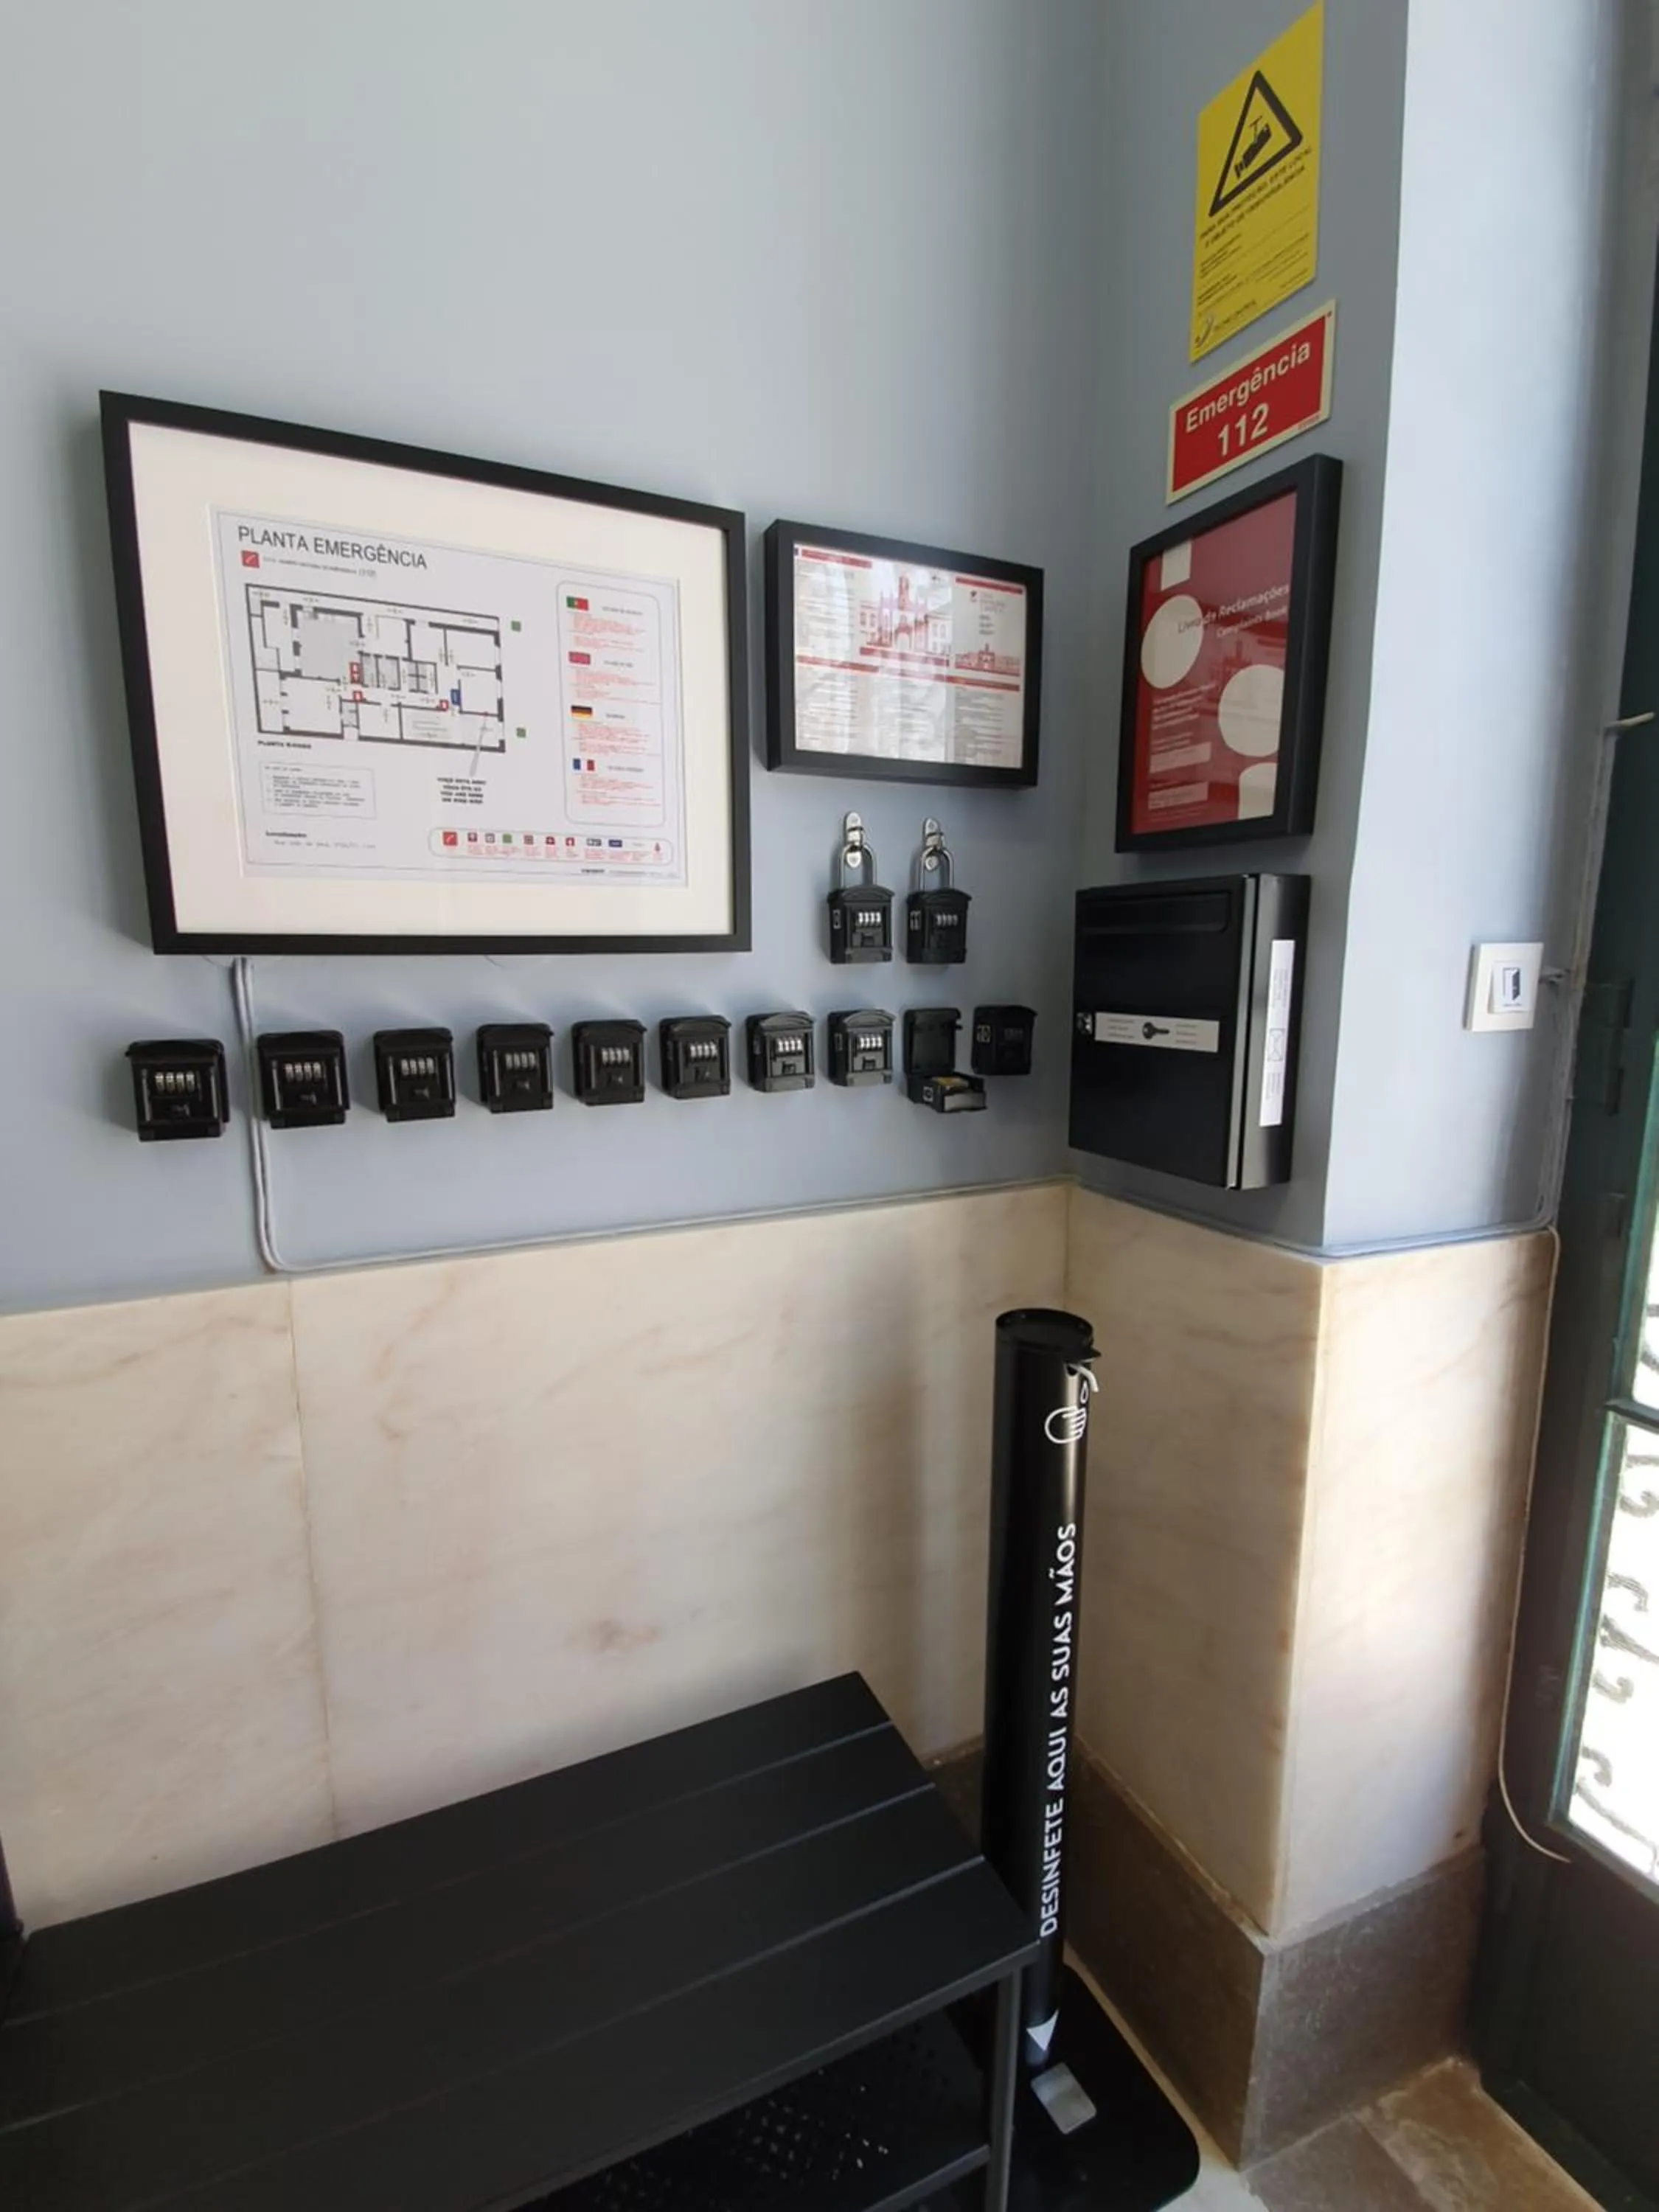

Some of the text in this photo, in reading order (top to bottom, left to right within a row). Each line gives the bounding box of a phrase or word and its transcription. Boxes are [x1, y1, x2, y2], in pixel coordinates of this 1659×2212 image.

[1186, 341, 1310, 433] Emergência
[1218, 403, 1269, 456] 112
[238, 526, 309, 552] PLANTA
[314, 538, 428, 569] EMERGÊNCIA
[1040, 1523, 1077, 1938] DESINFETE AQUI AS SUAS MÃOS
